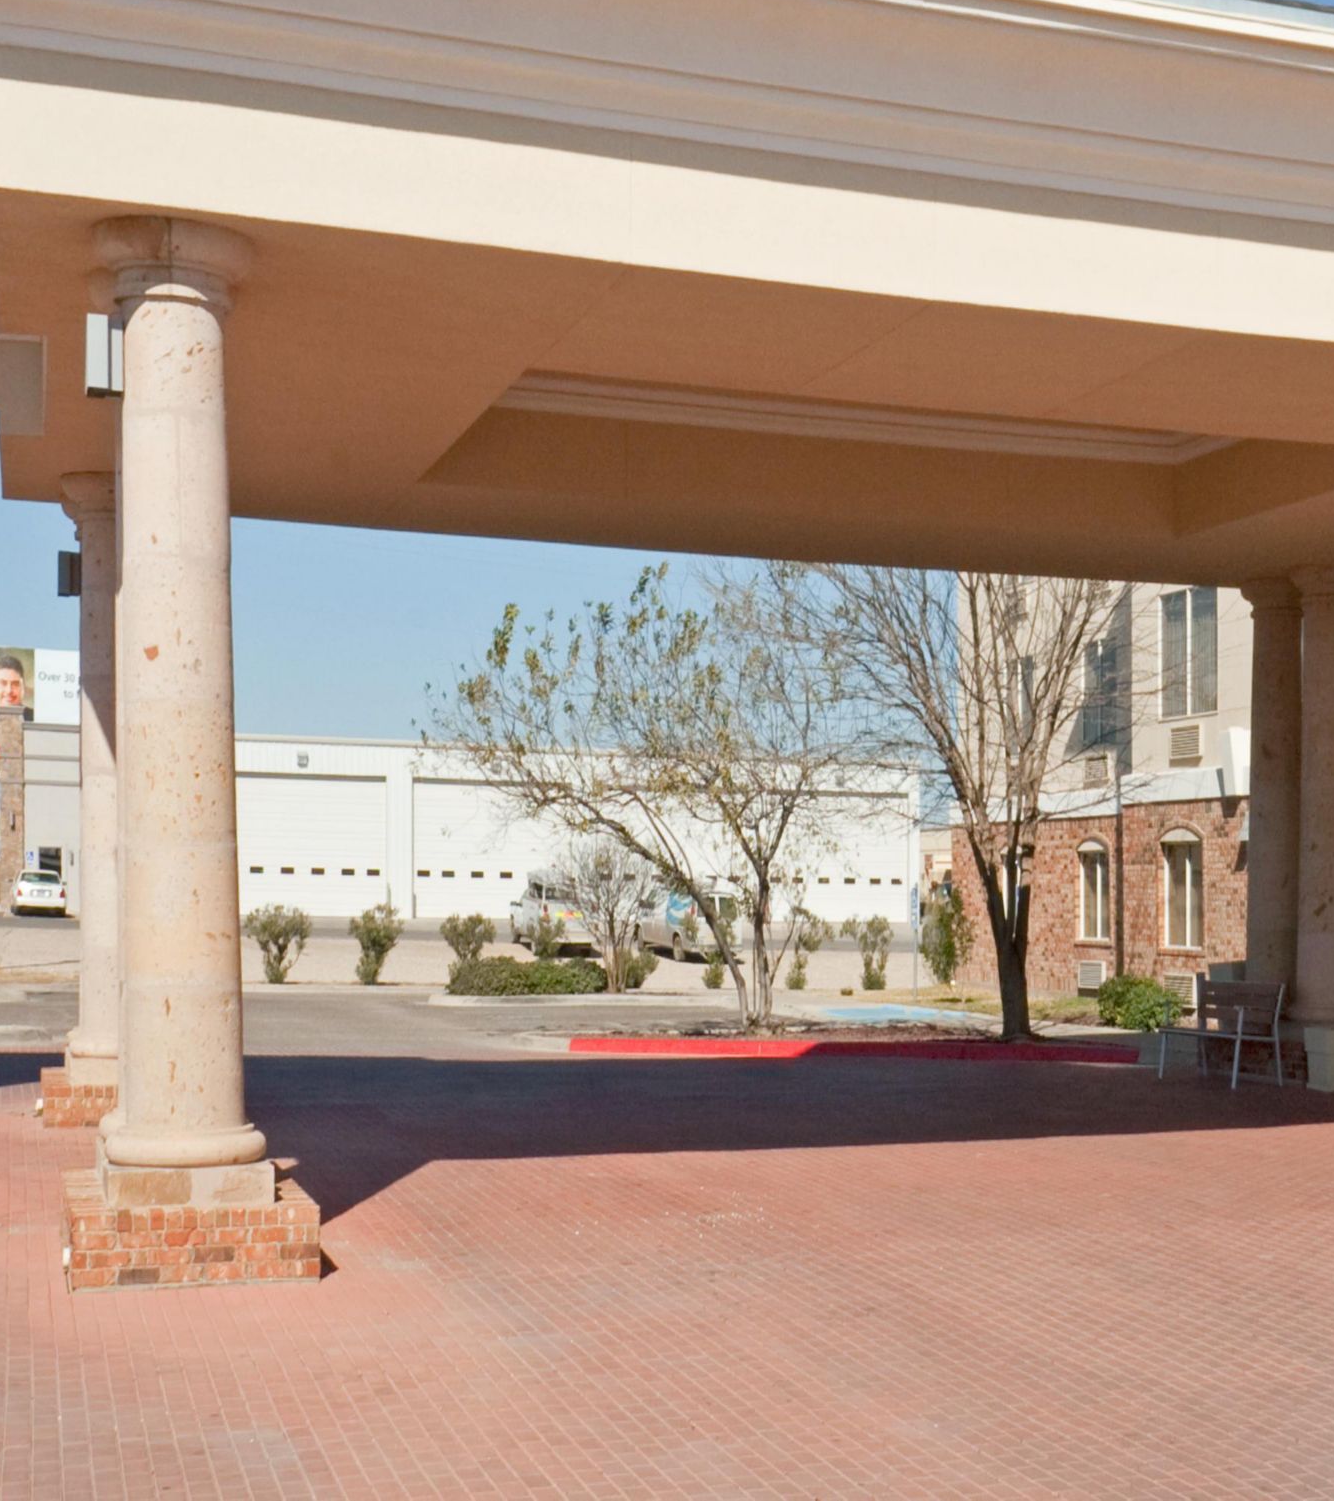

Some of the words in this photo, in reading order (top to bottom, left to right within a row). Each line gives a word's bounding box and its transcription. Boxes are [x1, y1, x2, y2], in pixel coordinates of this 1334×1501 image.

[37, 670, 62, 682] Over
[63, 672, 76, 683] 30
[63, 690, 74, 699] to
